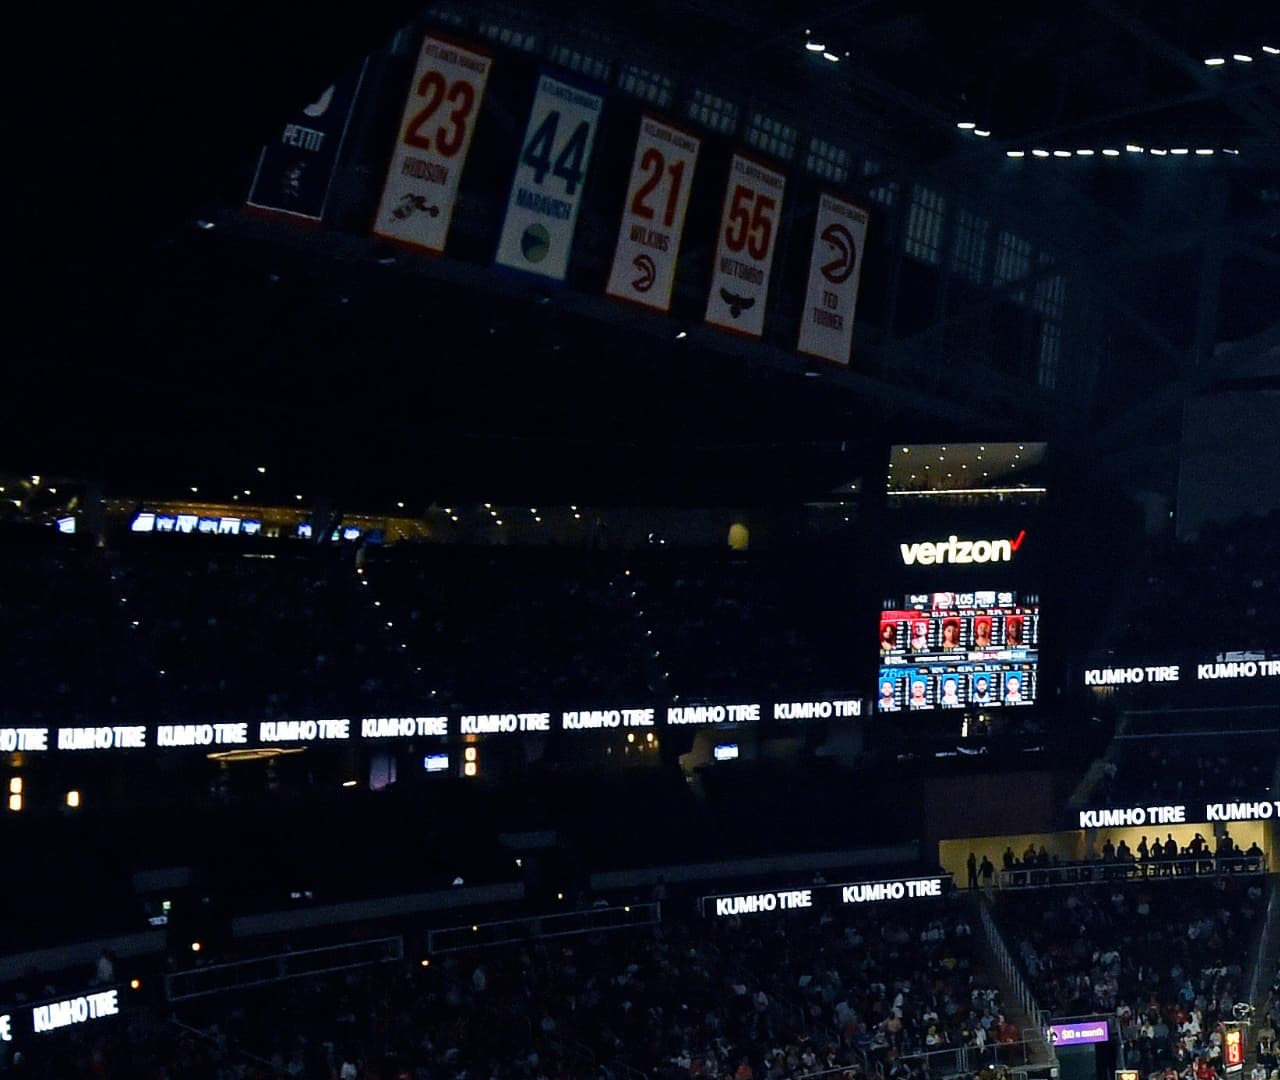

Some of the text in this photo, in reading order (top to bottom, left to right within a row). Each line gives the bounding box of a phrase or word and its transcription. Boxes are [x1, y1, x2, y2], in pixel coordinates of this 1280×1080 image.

[404, 70, 474, 157] 23
[523, 110, 590, 195] 44
[401, 156, 449, 186] HUDSON
[631, 148, 685, 227] 21
[725, 185, 776, 261] 55
[630, 224, 671, 252] WILKINS
[823, 291, 838, 310] TED
[900, 535, 1012, 565] verizon
[955, 593, 973, 604] 105
[997, 593, 1012, 604] 98
[1198, 662, 1257, 679] KUMHO
[563, 709, 654, 729] KUMHO TIRE
[774, 702, 832, 719] KUMHO
[157, 723, 247, 746] KUMHO TIRE
[362, 717, 448, 737] KUMHO TIRE
[17, 728, 48, 750] TIRE
[1080, 806, 1186, 828] KUMHO TIRE
[717, 890, 812, 915] KUMHO TIRE
[33, 996, 89, 1032] KUMHO
[88, 990, 118, 1018] TIRE
